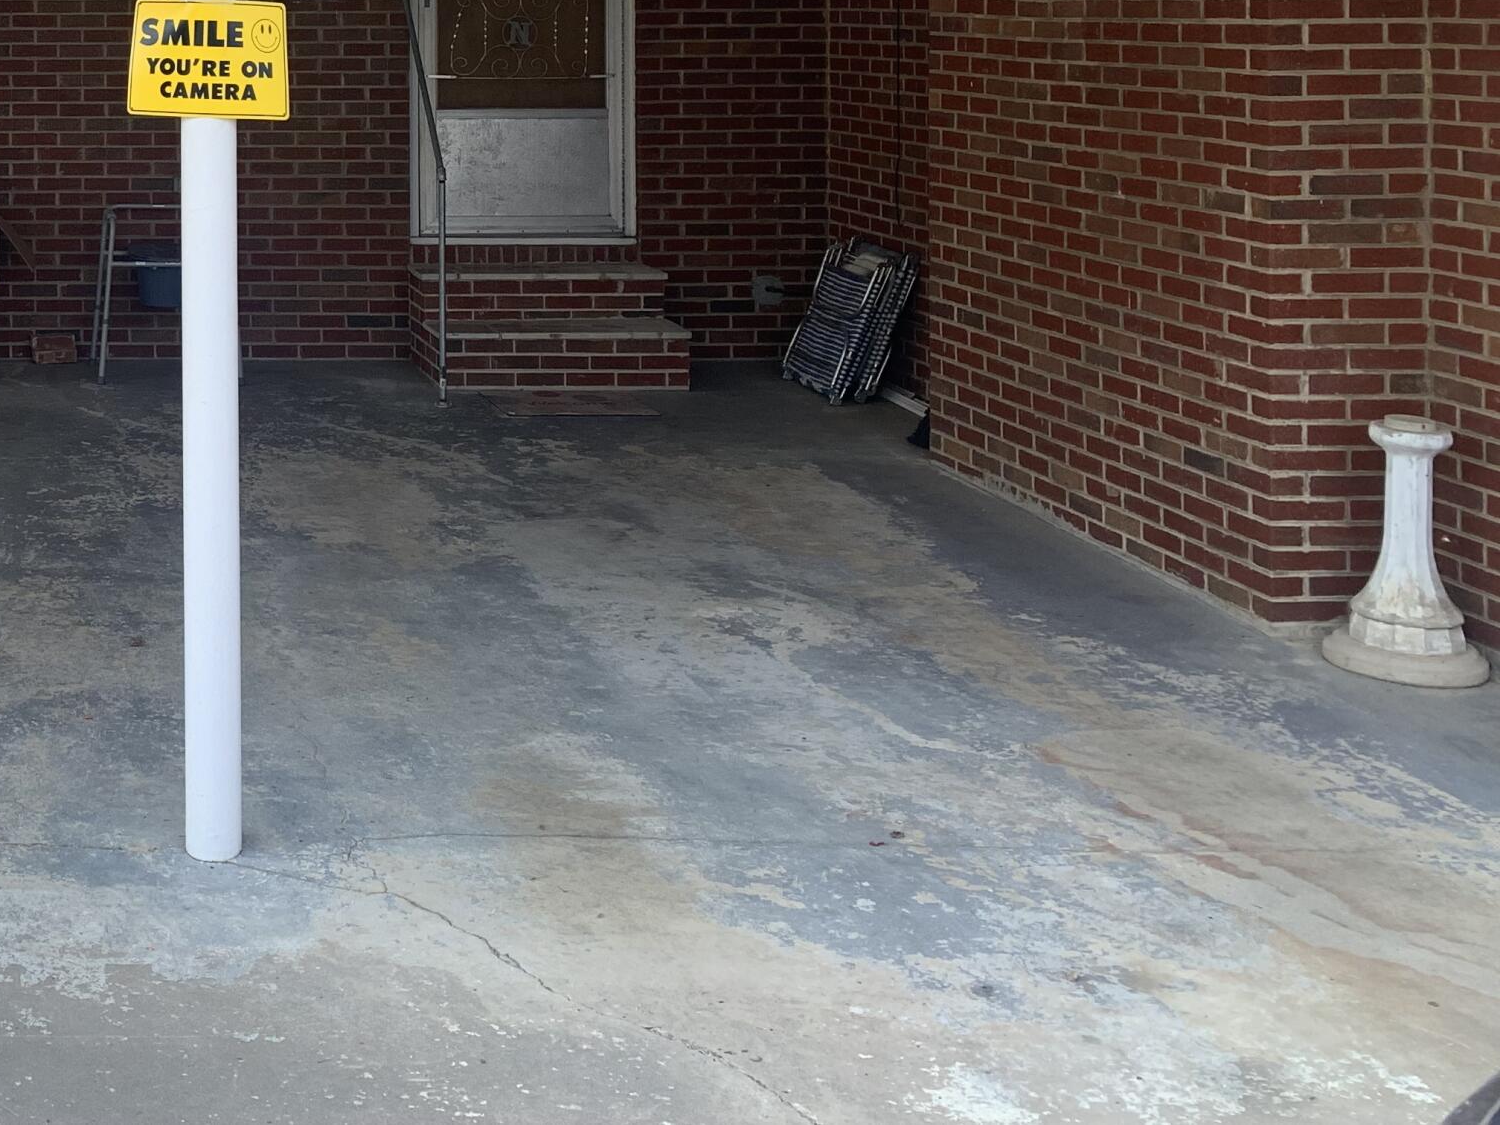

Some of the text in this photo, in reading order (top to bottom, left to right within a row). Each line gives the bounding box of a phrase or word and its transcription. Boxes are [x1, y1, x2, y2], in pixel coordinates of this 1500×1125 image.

[140, 18, 244, 47] SMILE
[146, 58, 273, 78] YOU'RE ON
[160, 81, 257, 101] CAMERA
